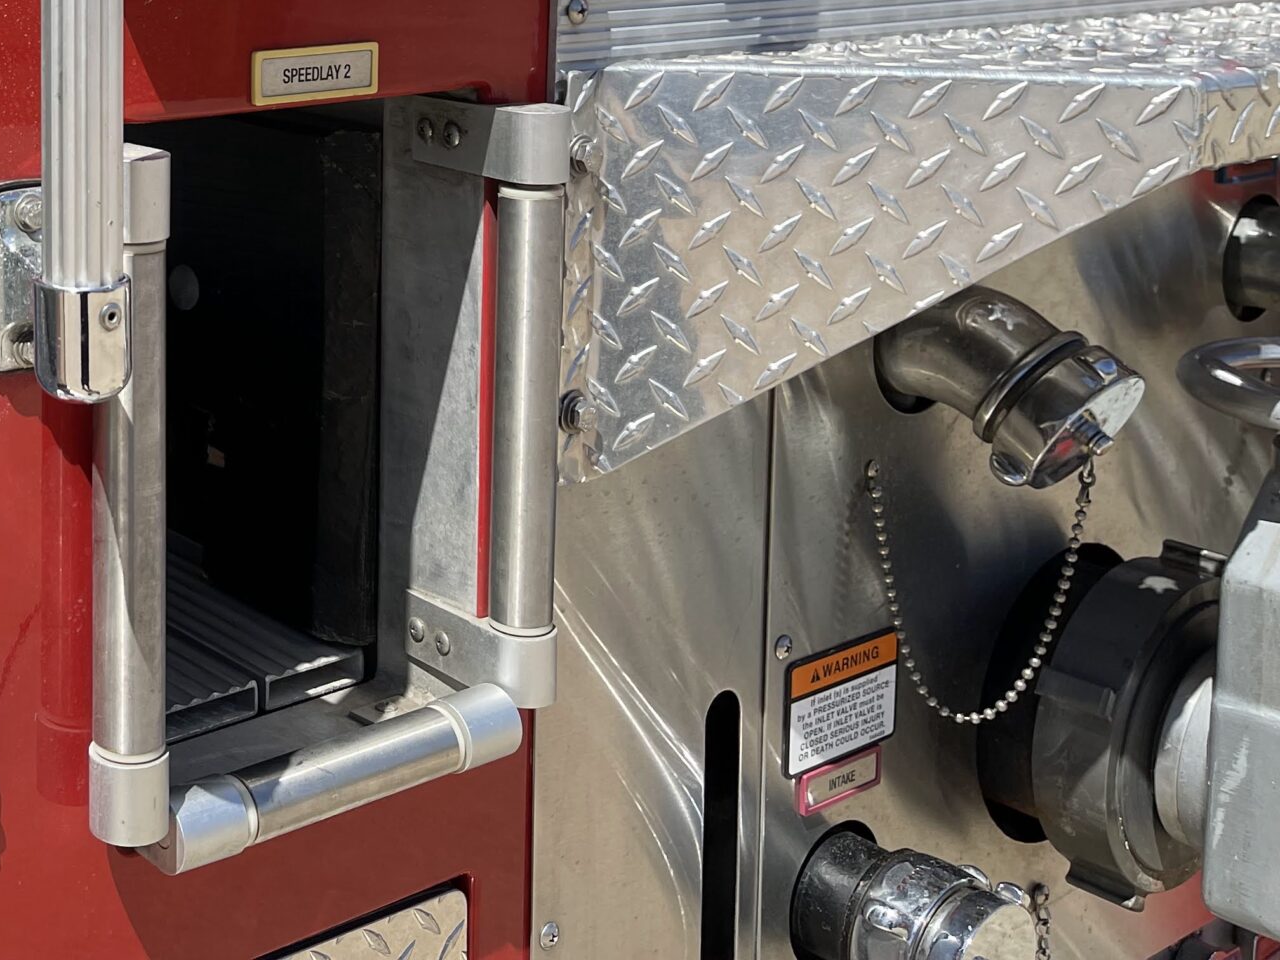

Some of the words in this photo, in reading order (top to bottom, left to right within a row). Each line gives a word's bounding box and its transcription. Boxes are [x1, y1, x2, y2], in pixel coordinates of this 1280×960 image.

[283, 64, 341, 84] SPEEDLAY
[344, 64, 351, 79] 2
[822, 646, 879, 678] WARNING
[797, 715, 805, 723] by
[813, 692, 860, 717] PRESSURIZED
[862, 680, 889, 697] SOURCE
[818, 693, 832, 705] inlet
[851, 675, 878, 693] supplied
[802, 720, 813, 730] the
[815, 712, 835, 725] INLET
[836, 702, 857, 717] VALVE
[859, 695, 875, 708] must
[876, 693, 884, 701] be
[804, 727, 825, 740] OPEN.
[833, 714, 852, 728] INLET
[854, 705, 875, 719] VALVE
[798, 752, 808, 762] OR
[810, 742, 834, 757] DEATH
[835, 731, 859, 748] COULD
[860, 721, 885, 737] OCCUR.
[800, 734, 828, 751] CLOSED
[830, 722, 859, 739] SERIOUS
[861, 711, 885, 726] INJURY
[829, 769, 856, 792] INTAKE
